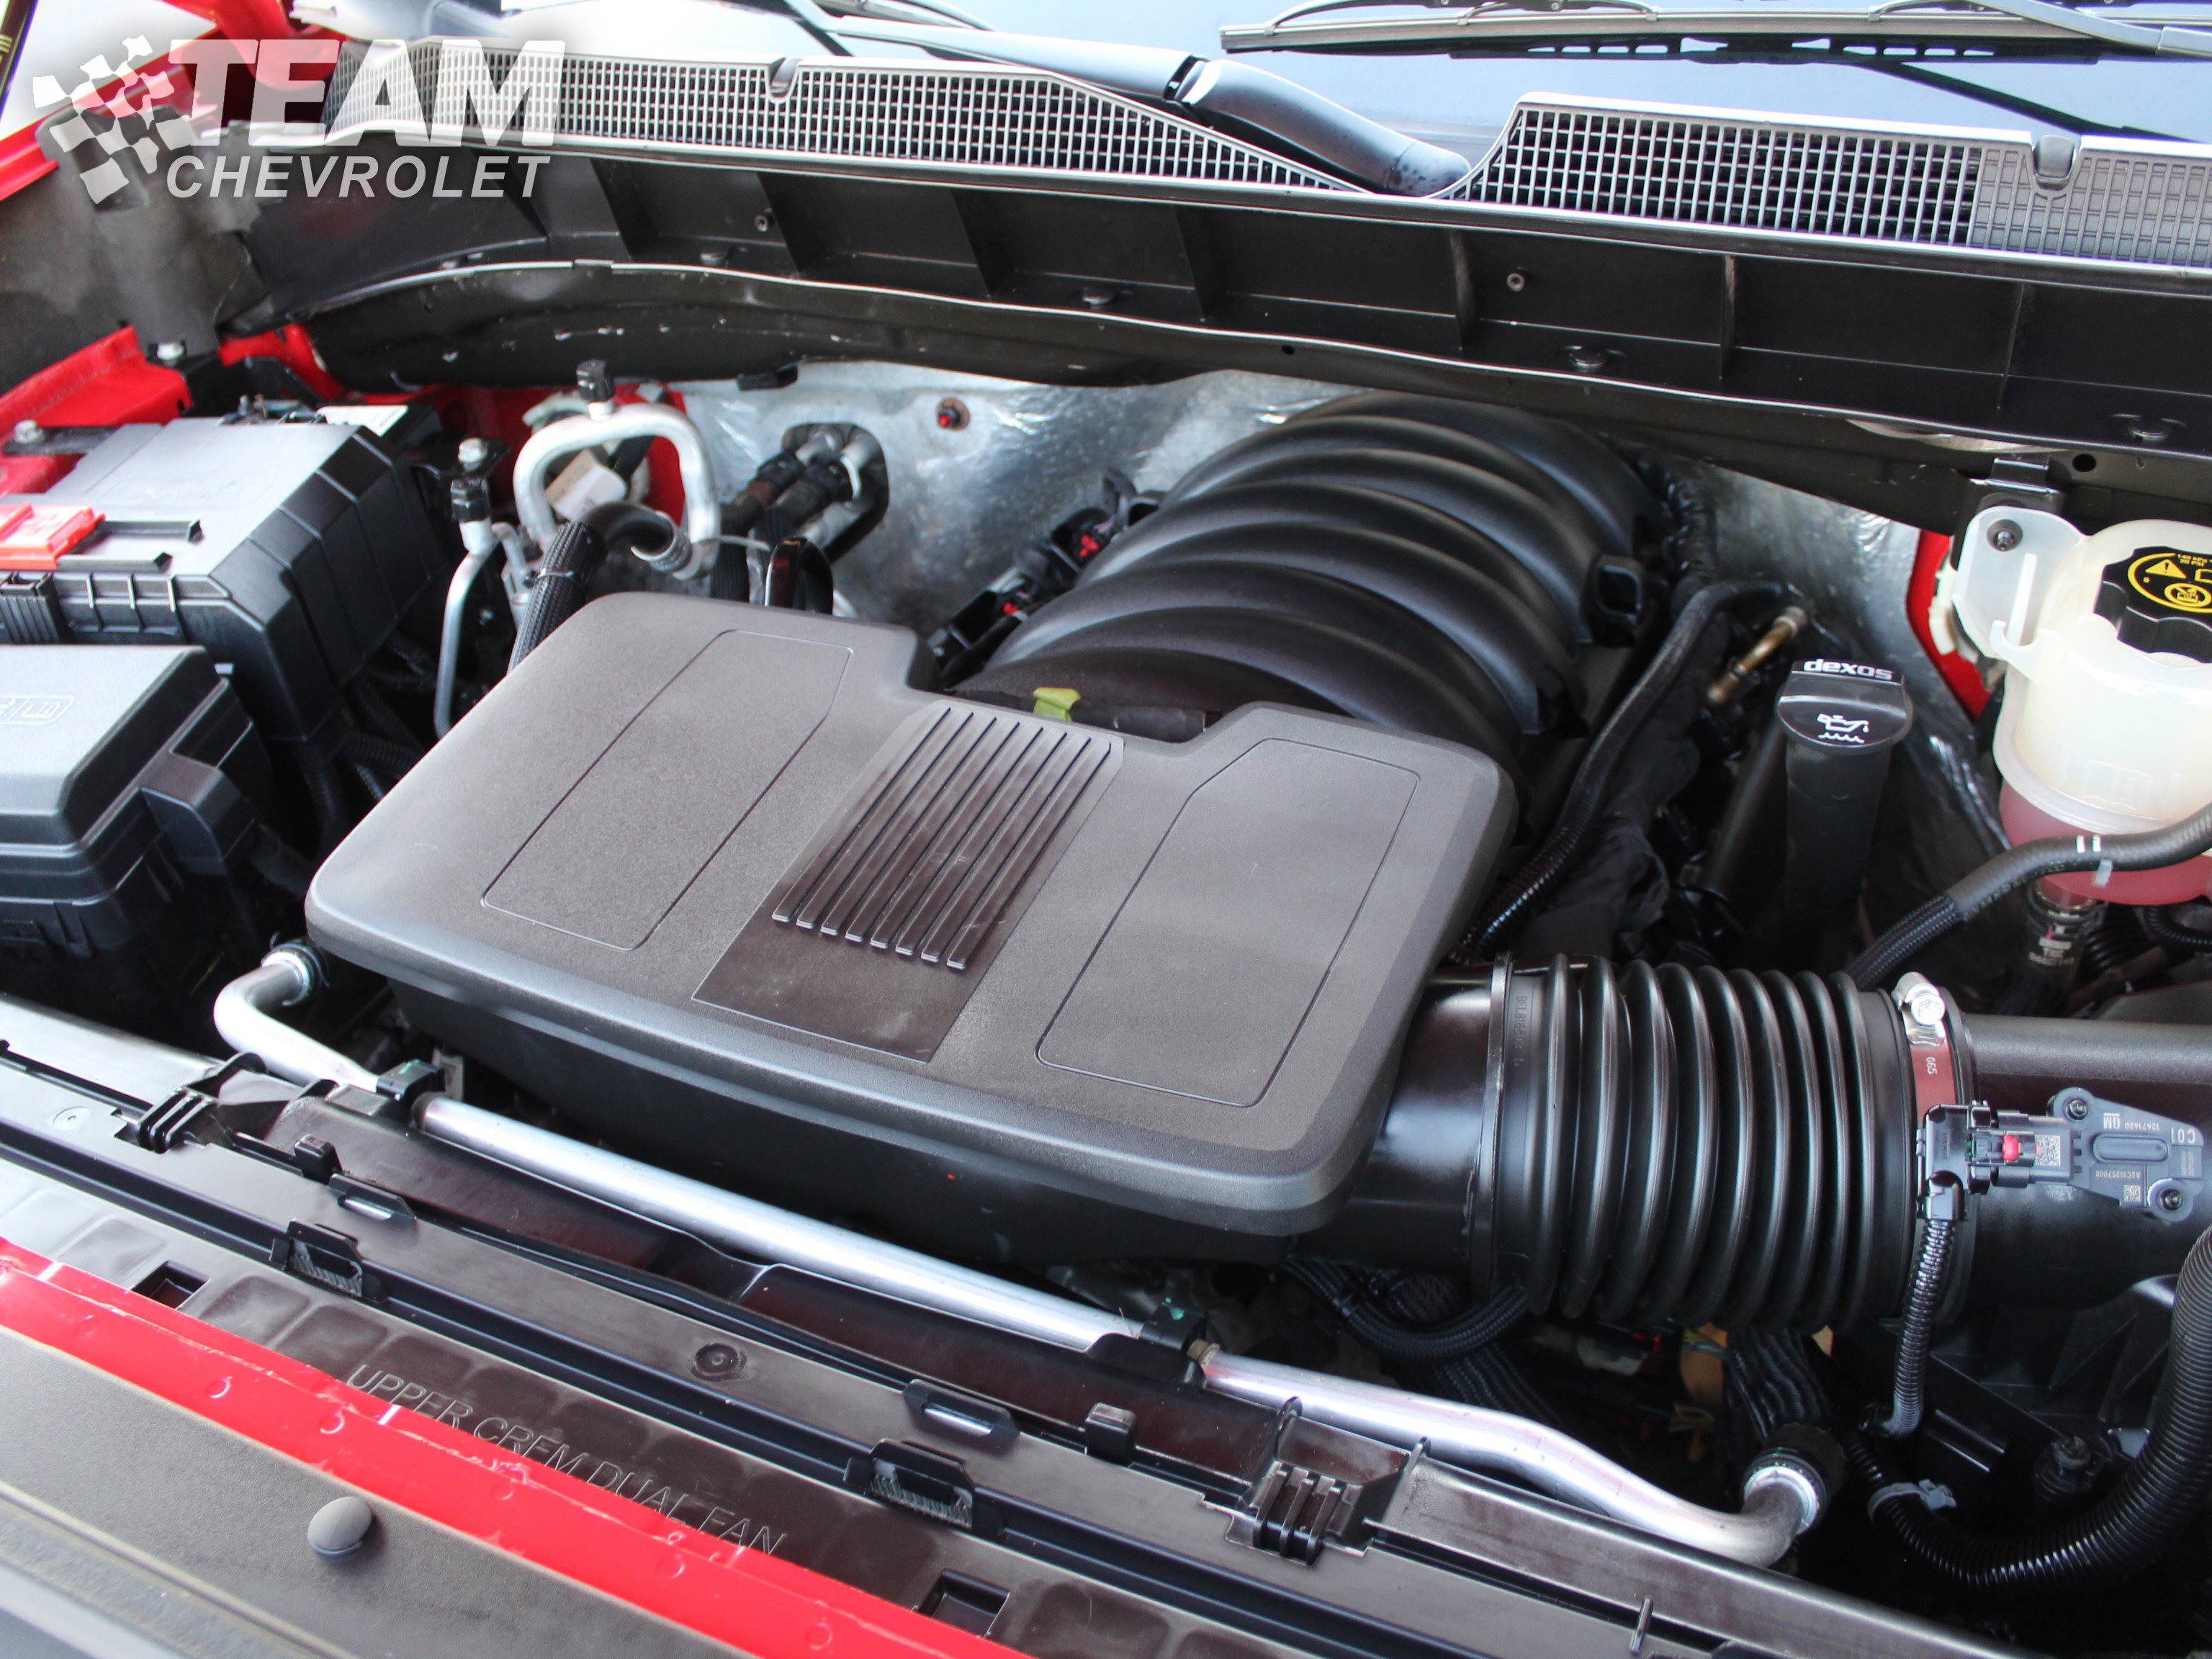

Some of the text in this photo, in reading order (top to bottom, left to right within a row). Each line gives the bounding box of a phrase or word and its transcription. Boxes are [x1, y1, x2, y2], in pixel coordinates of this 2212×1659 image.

[1803, 658, 1893, 680] dexos
[1925, 1056, 1938, 1075] 065
[2103, 1113, 2159, 1131] 12671620 GM
[346, 1364, 474, 1429] UPPER
[586, 1461, 690, 1525] DUAL
[698, 1506, 788, 1555] FAN
